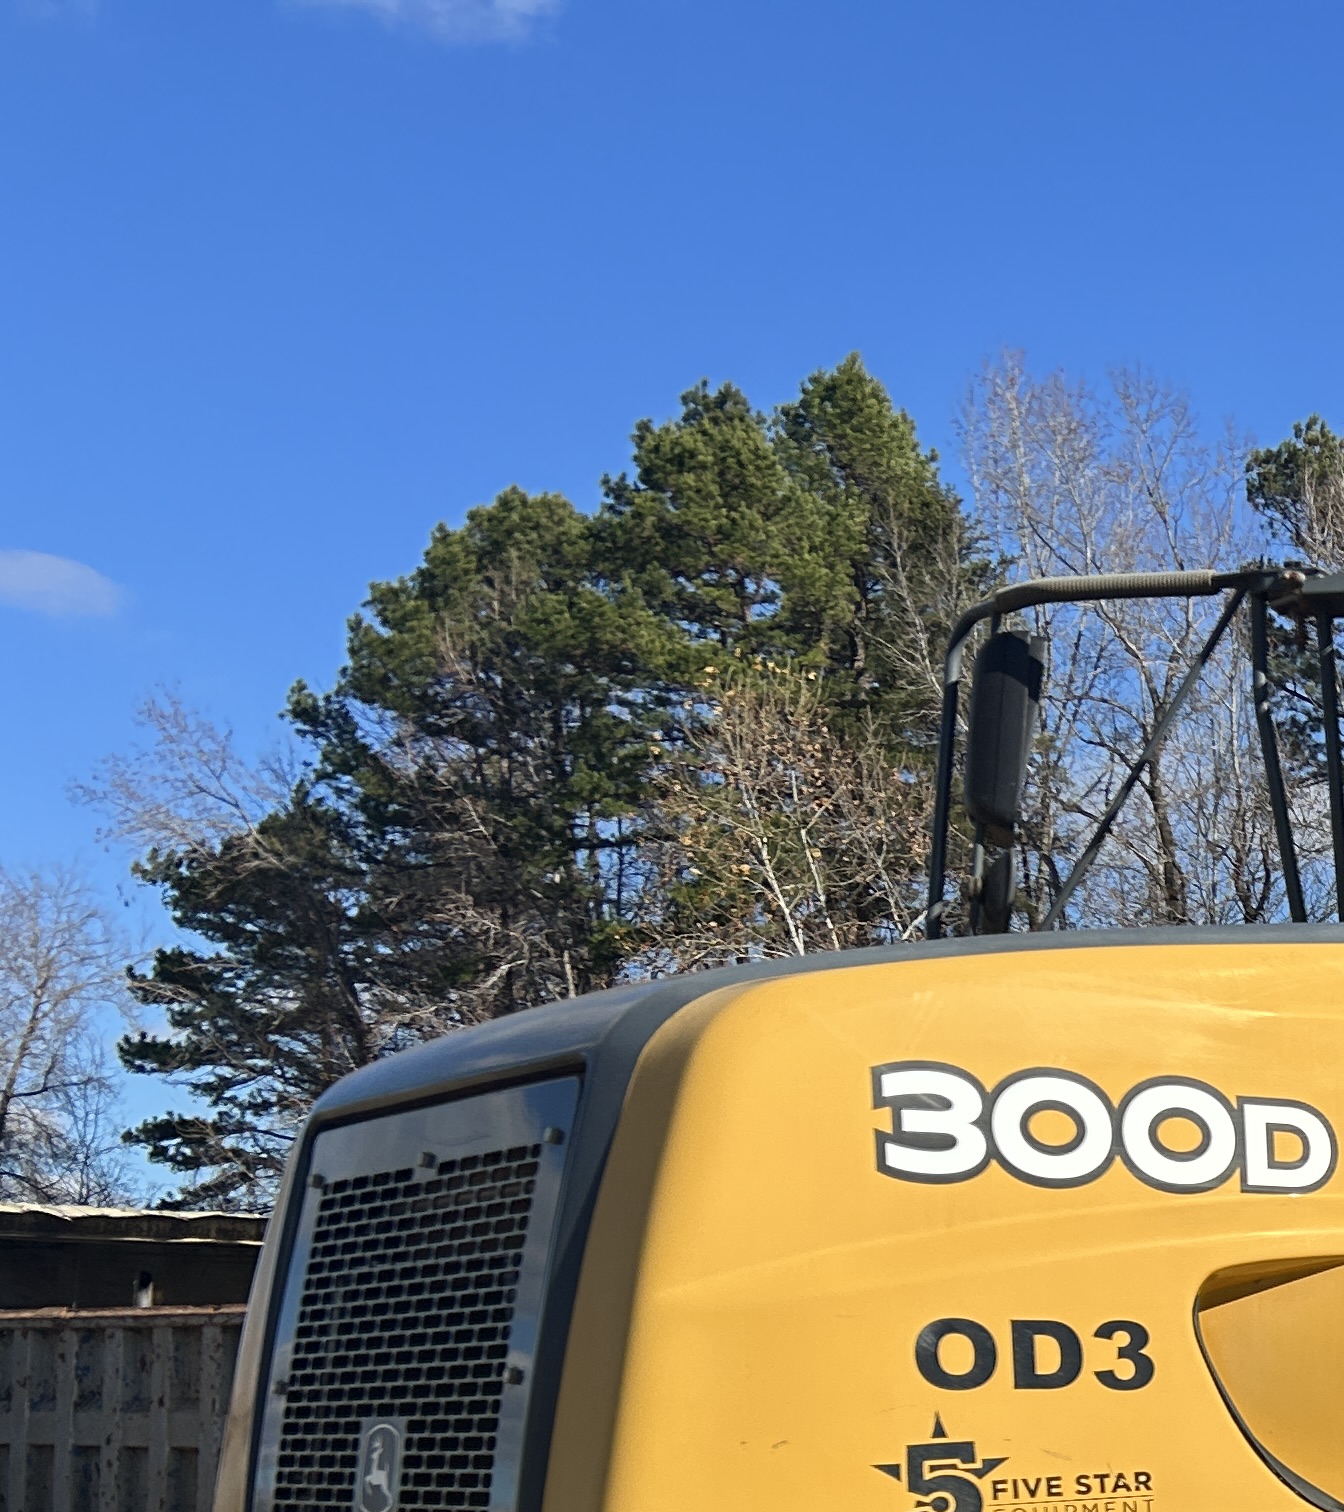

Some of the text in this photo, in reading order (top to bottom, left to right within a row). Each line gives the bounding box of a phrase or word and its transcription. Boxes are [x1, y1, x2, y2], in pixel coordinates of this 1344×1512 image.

[870, 1060, 1338, 1194] 300D
[915, 1317, 1156, 1391] OD3
[991, 1471, 1153, 1501] FIVE STAR
